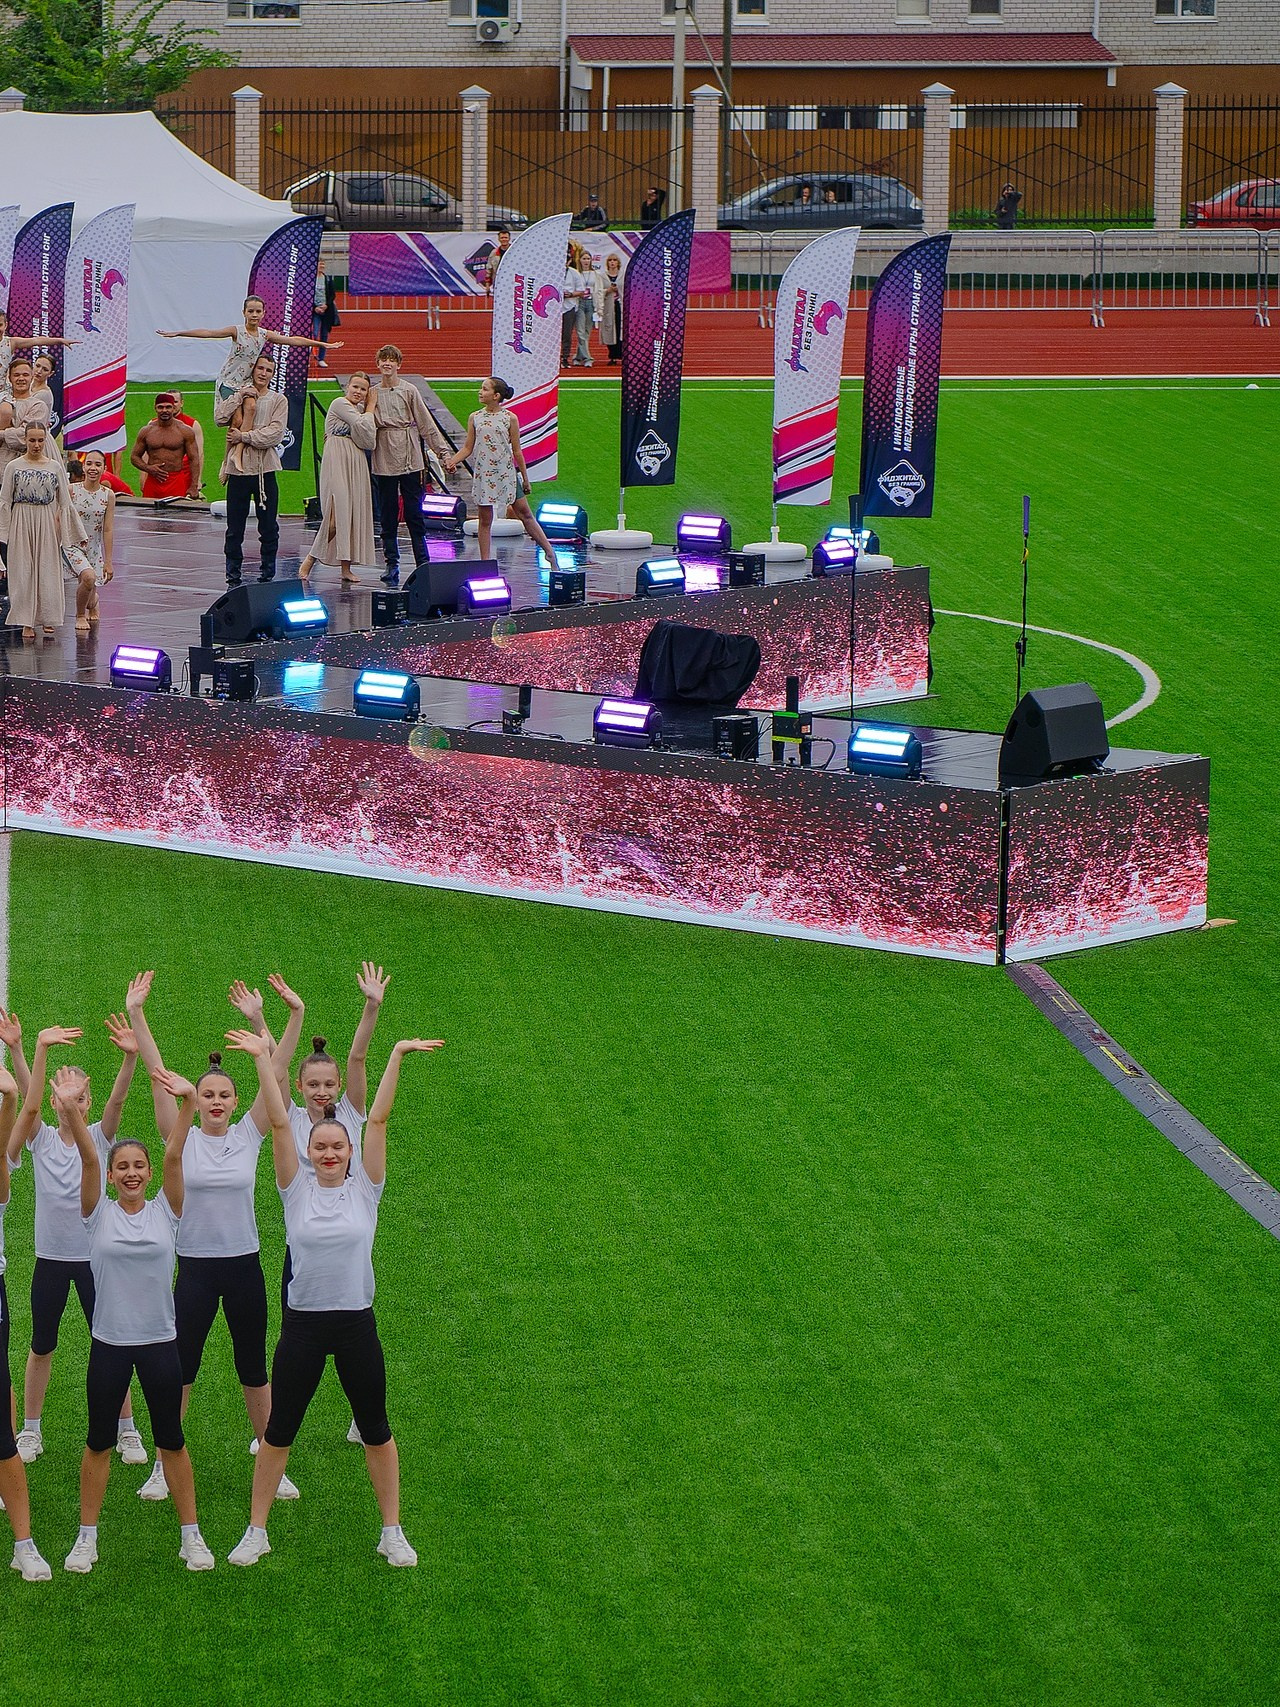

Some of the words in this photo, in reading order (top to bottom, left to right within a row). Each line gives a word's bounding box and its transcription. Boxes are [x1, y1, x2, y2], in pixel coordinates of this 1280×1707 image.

[42, 233, 51, 252] СНГ
[290, 244, 299, 264] СНГ
[663, 247, 672, 267] СНГ
[41, 252, 50, 282] СТРАН
[95, 261, 103, 294] ГРАНИЦ
[287, 264, 297, 295] СТРАН
[912, 269, 922, 290] СНГ
[41, 284, 49, 312] ИГРЫ
[526, 277, 536, 313] ГРАНИЦ
[663, 268, 672, 300] СТРАН
[284, 295, 294, 323] ИГРЫ
[525, 314, 534, 334] БЕЗ
[807, 292, 818, 329] ГРАНИЦ
[910, 292, 921, 326] СТРАН
[804, 331, 812, 351] БЕЗ
[908, 327, 919, 357] ИГРЫ
[893, 366, 906, 446] ИНКЛЮЗИВНЫЕ
[903, 358, 917, 452] МЕЖДУНАРОДНЫЕ
